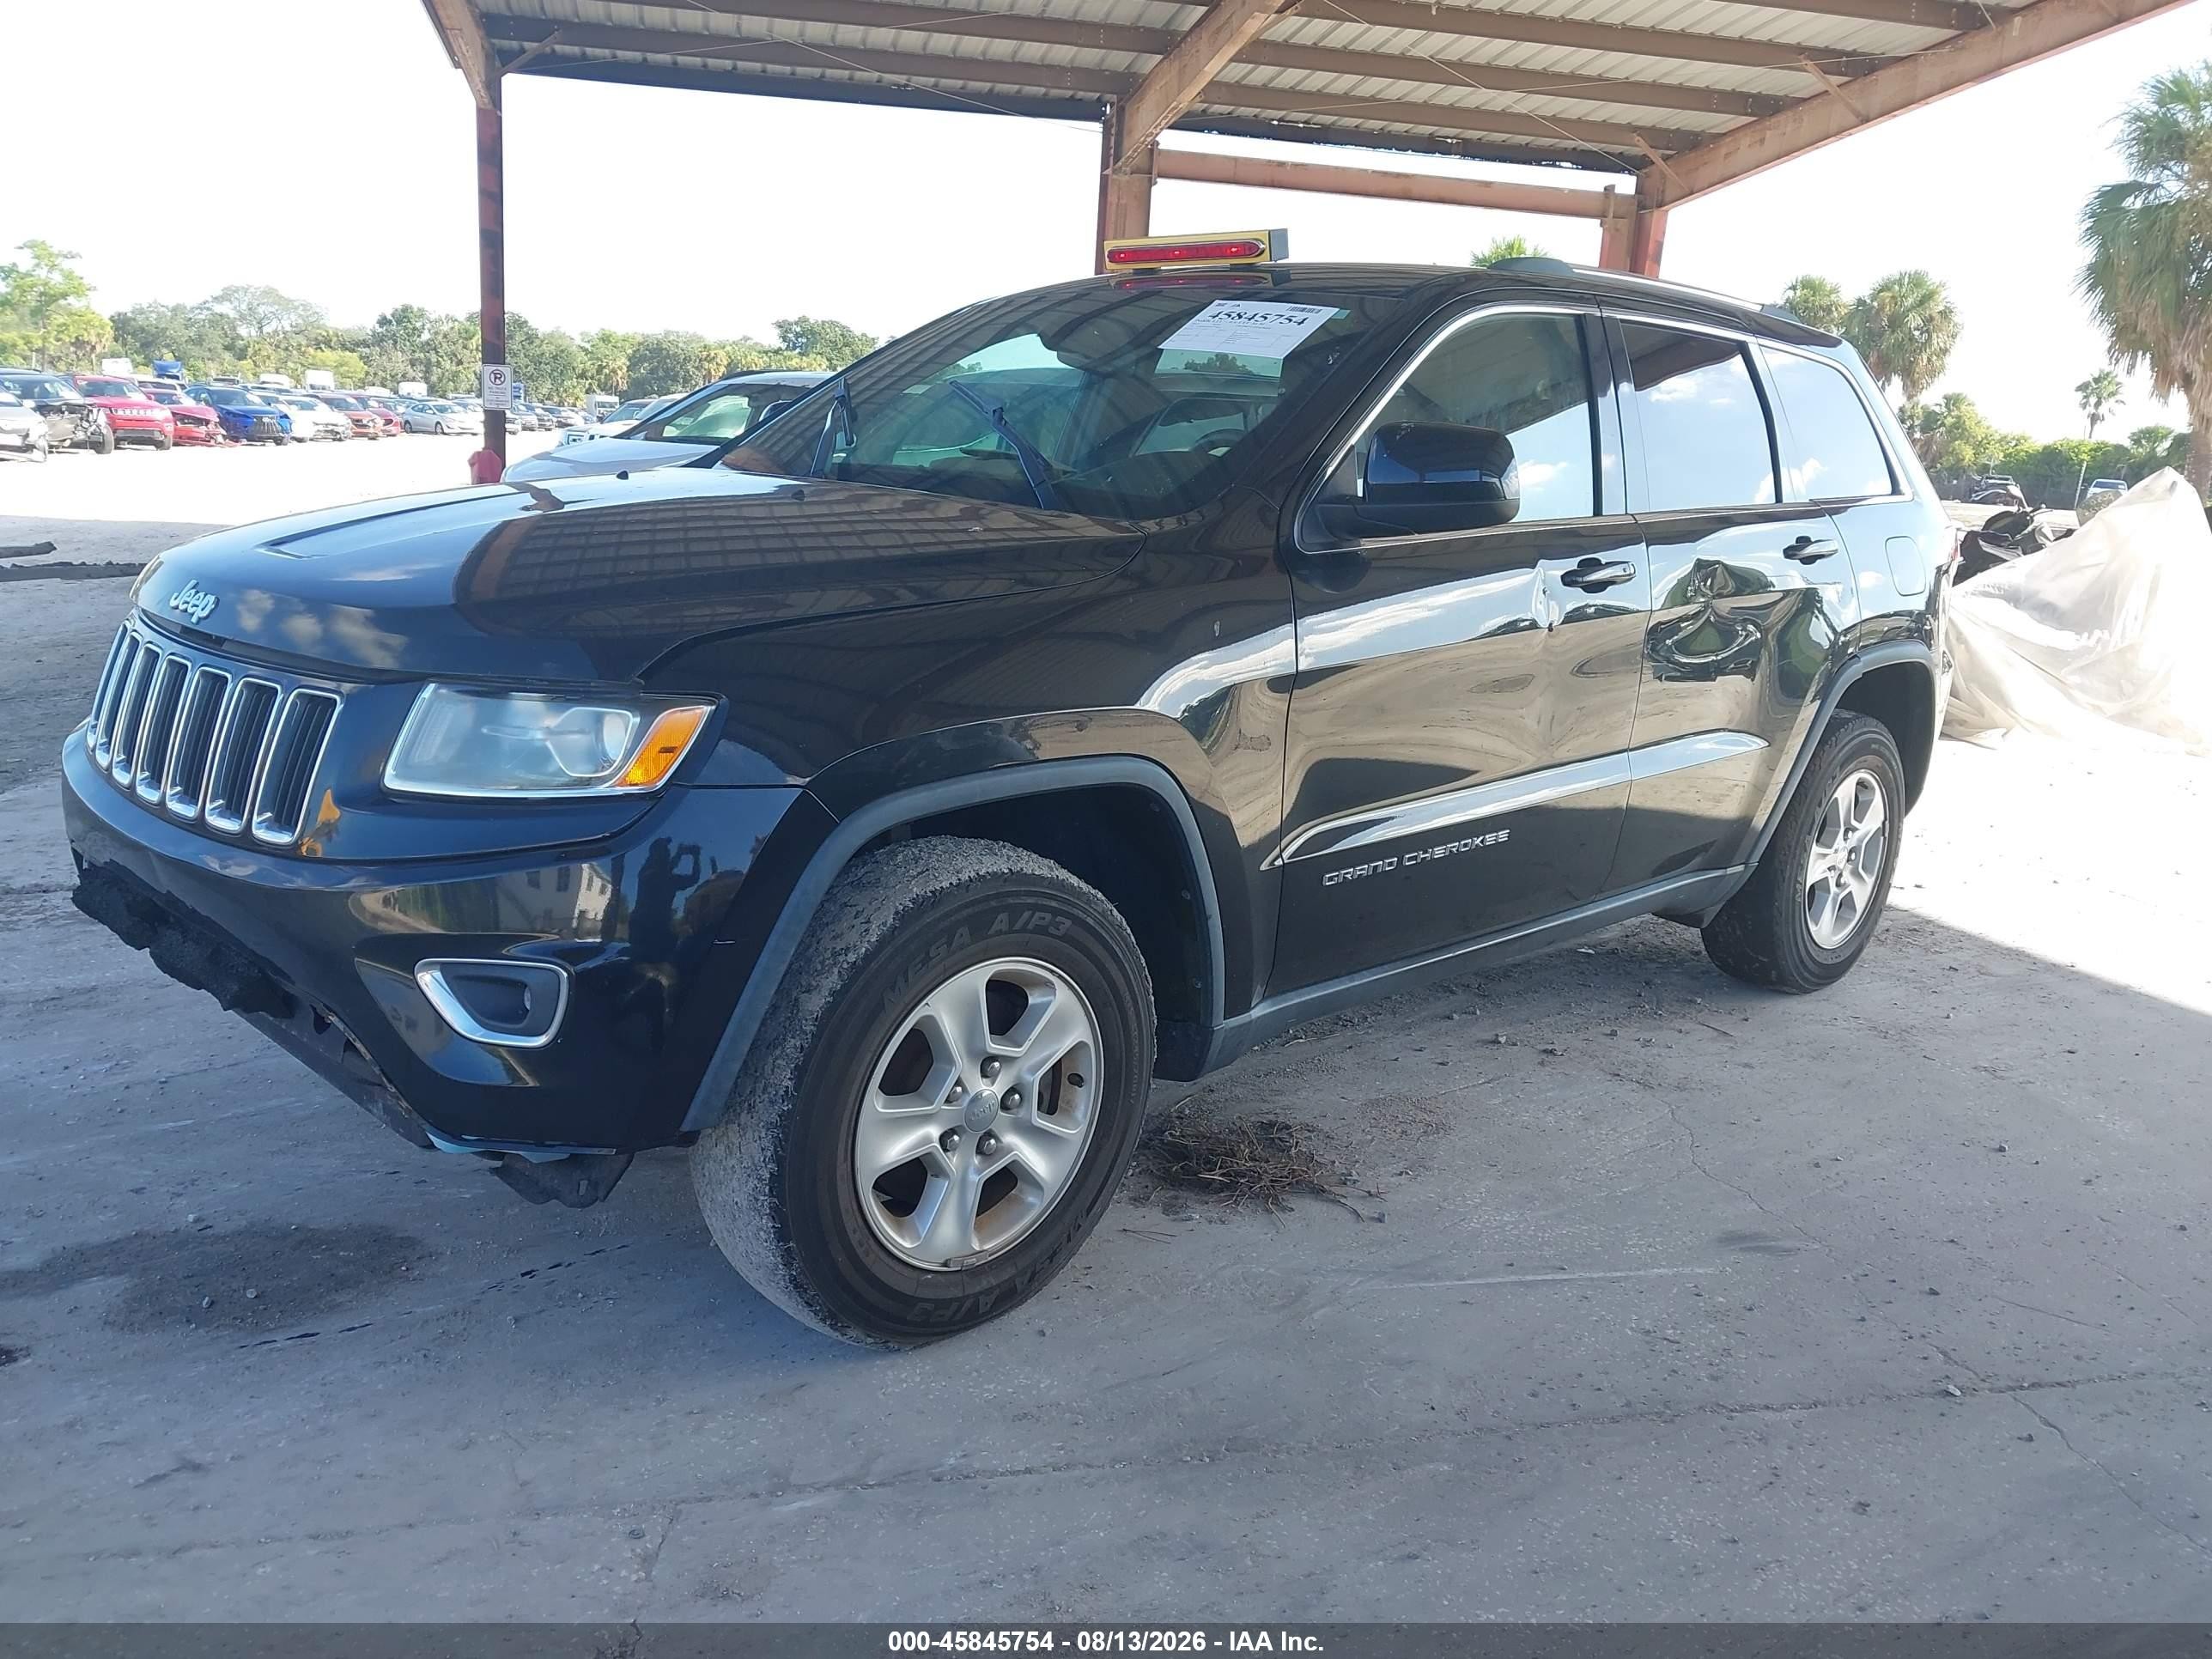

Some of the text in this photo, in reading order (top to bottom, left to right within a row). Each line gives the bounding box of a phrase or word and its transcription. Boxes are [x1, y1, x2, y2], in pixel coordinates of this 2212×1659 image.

[1208, 310, 1310, 326] 45845754
[169, 579, 218, 624] Jeep
[1322, 830, 1510, 886] GRAND CHEROKEE
[988, 910, 1072, 937] A/P3
